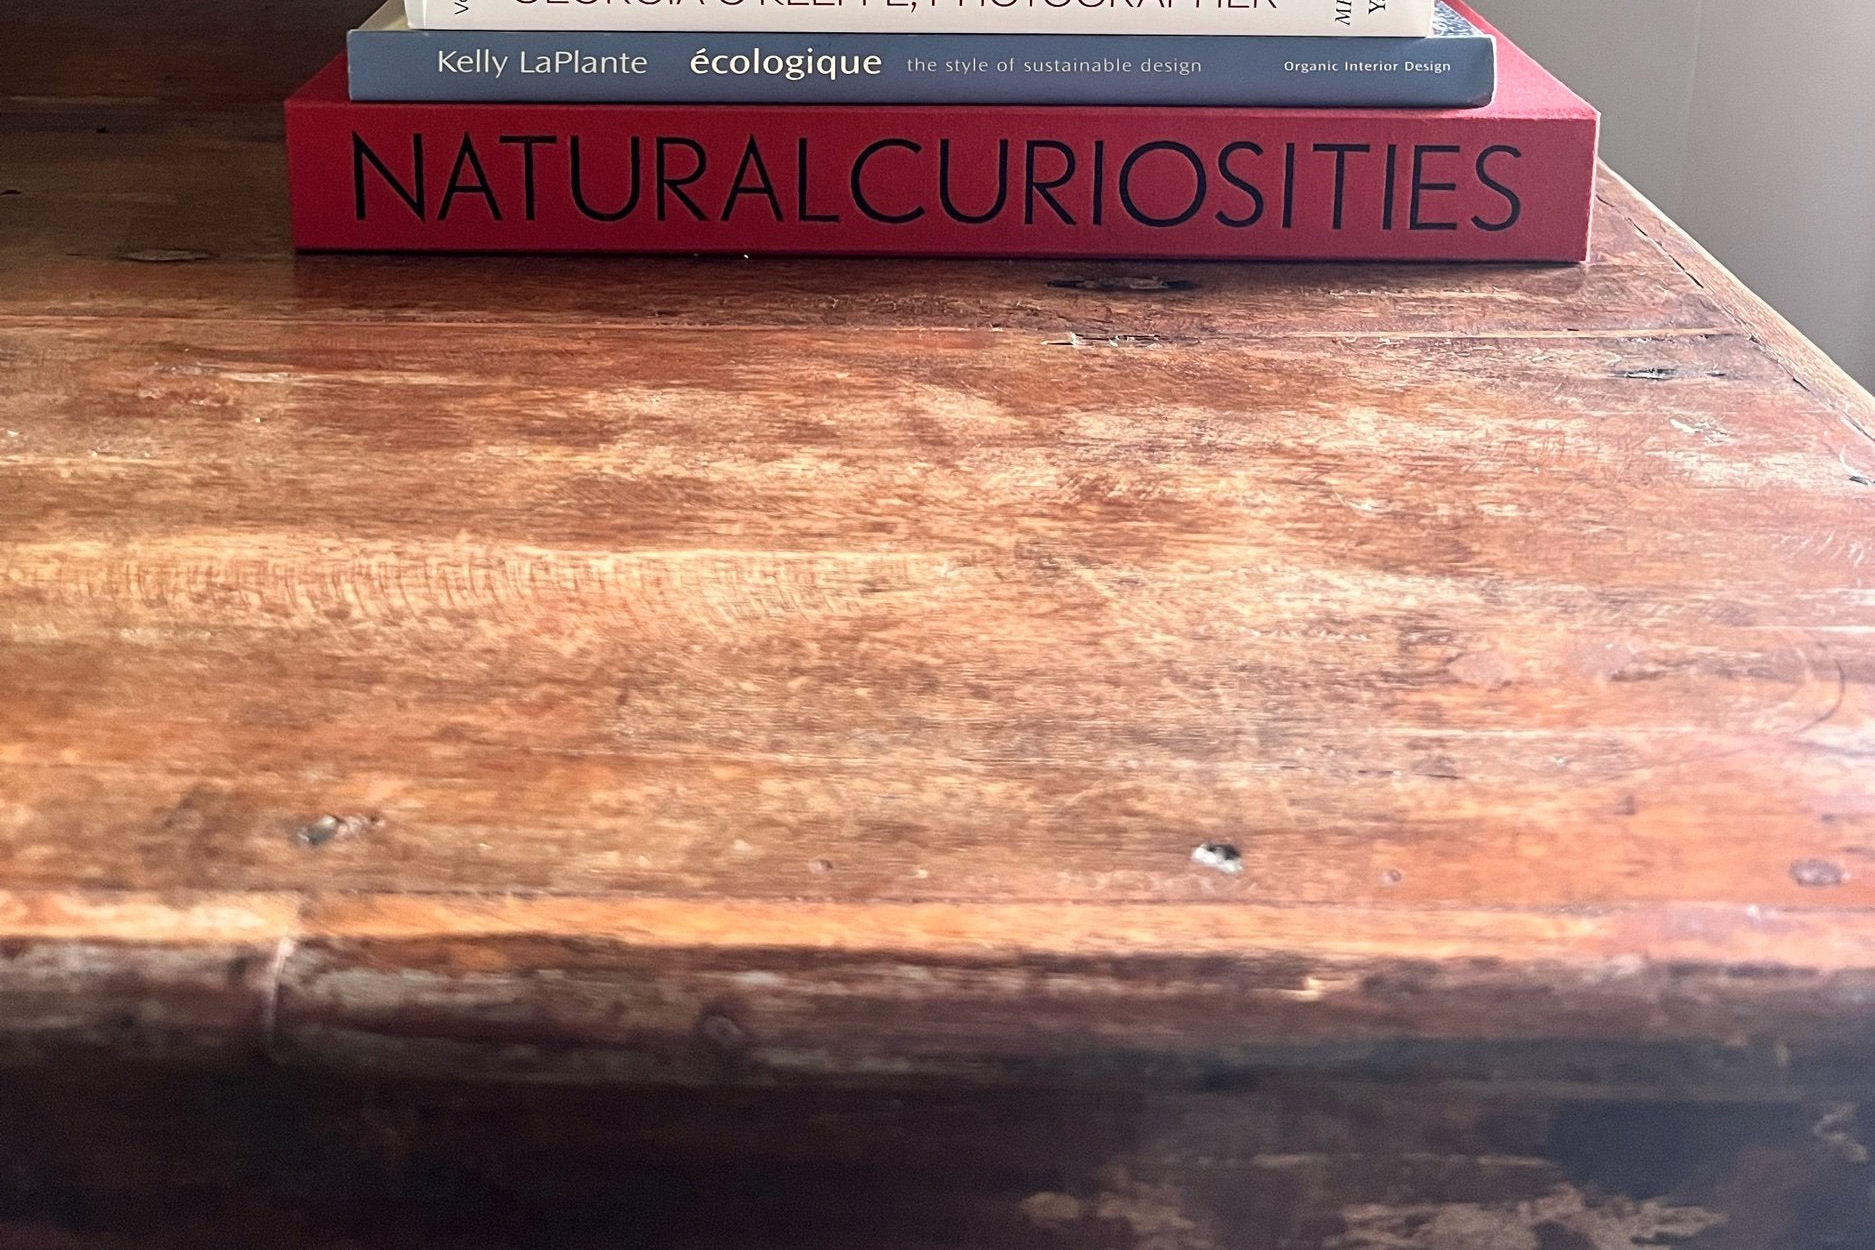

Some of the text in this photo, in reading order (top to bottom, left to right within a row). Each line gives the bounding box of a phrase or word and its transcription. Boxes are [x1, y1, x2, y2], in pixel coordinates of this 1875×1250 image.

[437, 48, 648, 79] Kelly LaPlante
[690, 47, 882, 81] écologique
[906, 56, 1202, 77] the style of sustainable design
[1283, 60, 1451, 75] Organic Interior Design
